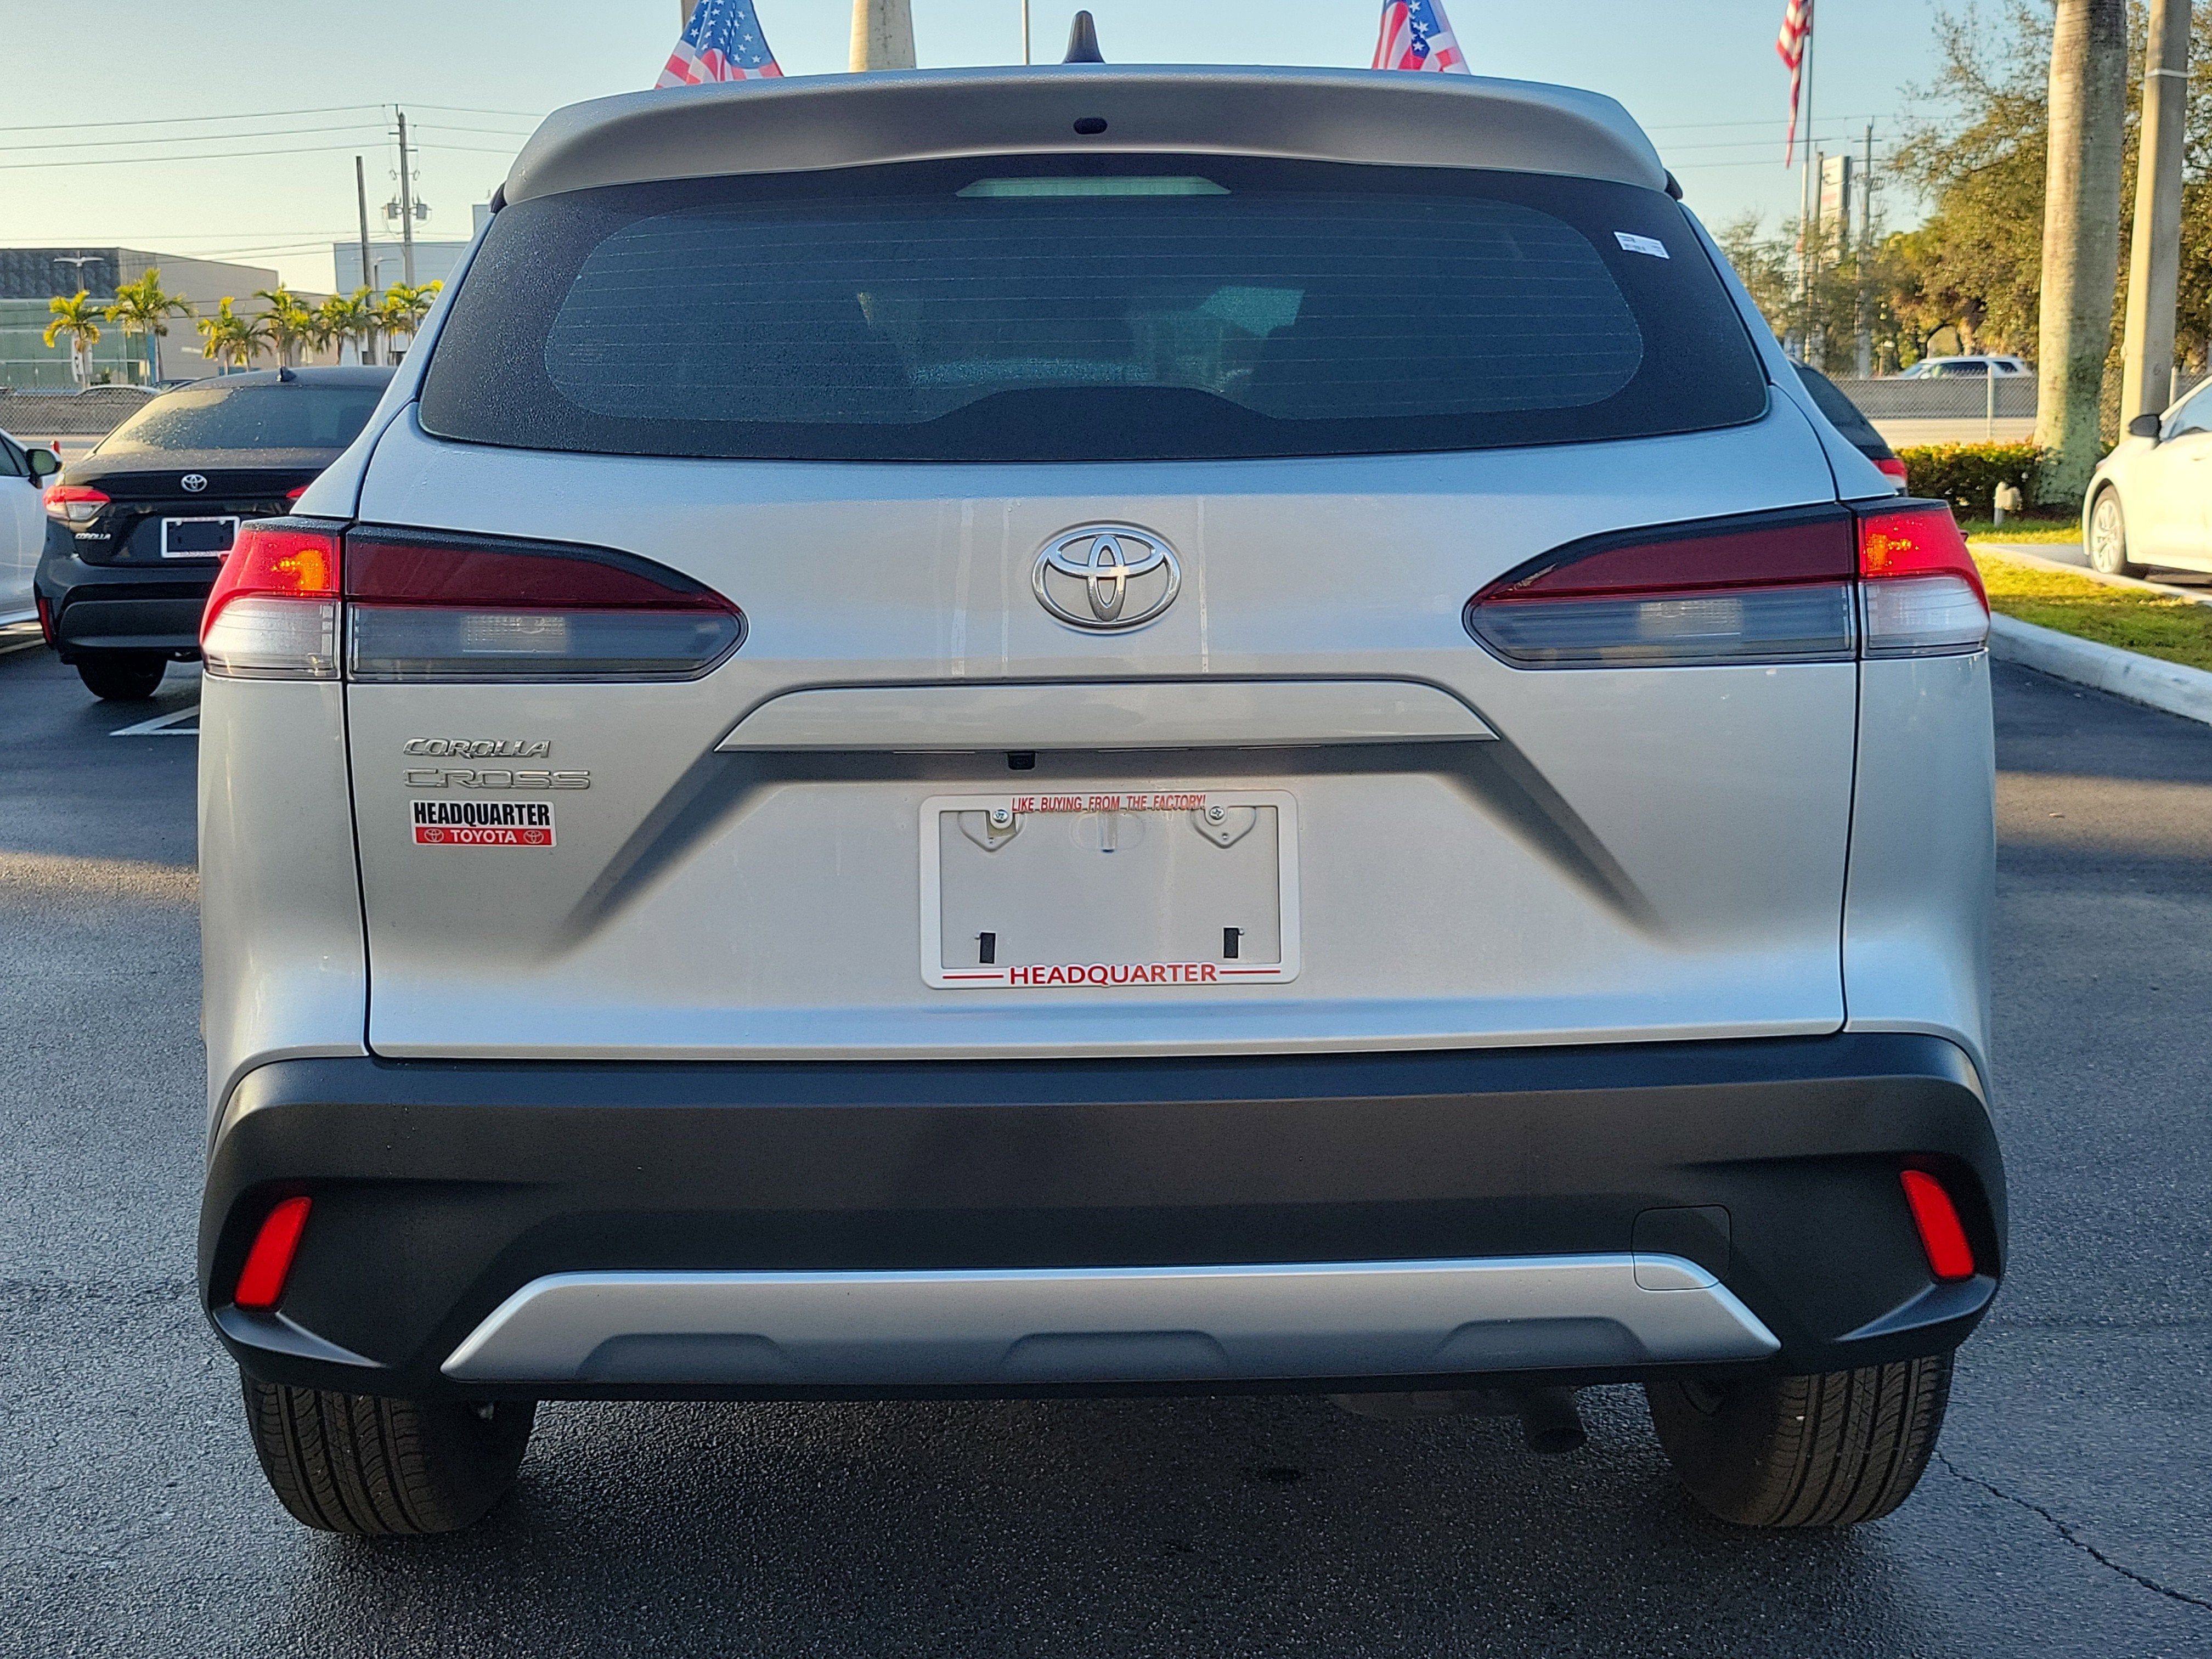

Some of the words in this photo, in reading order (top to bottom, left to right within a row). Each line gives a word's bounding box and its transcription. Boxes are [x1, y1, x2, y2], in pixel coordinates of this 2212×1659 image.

[403, 738, 551, 759] COROLLA
[404, 768, 590, 789] CROSS
[1012, 797, 1034, 811] LIKE
[1040, 797, 1082, 810] BUYING
[1088, 796, 1120, 810] FROM
[1126, 795, 1148, 810] THE
[1153, 795, 1206, 810] FACTORY!
[415, 803, 550, 826] HEADQUARTER
[450, 830, 517, 843] TOYOTA
[1010, 964, 1217, 985] HEADQUARTER
